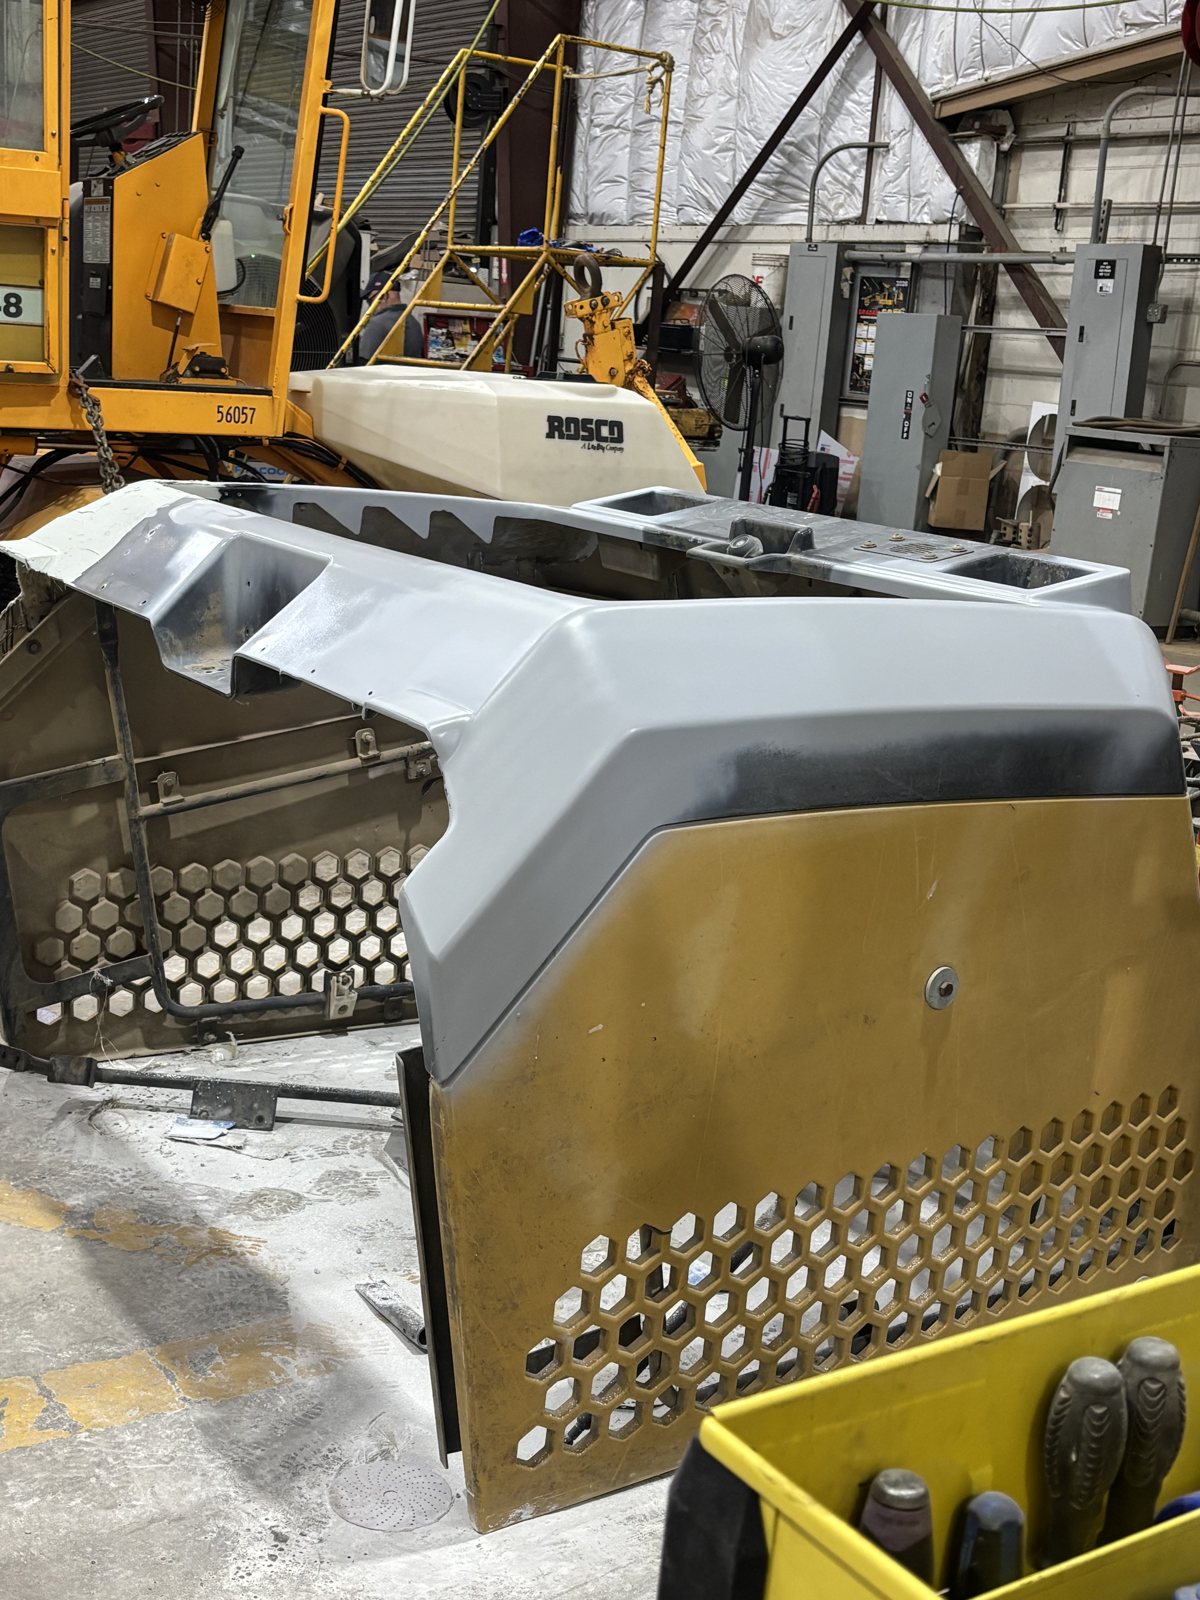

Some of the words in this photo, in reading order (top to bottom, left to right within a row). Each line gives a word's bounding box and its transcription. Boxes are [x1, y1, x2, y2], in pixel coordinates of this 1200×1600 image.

[0, 292, 23, 318] 8
[216, 405, 256, 424] 56057
[545, 414, 624, 444] ROSCO
